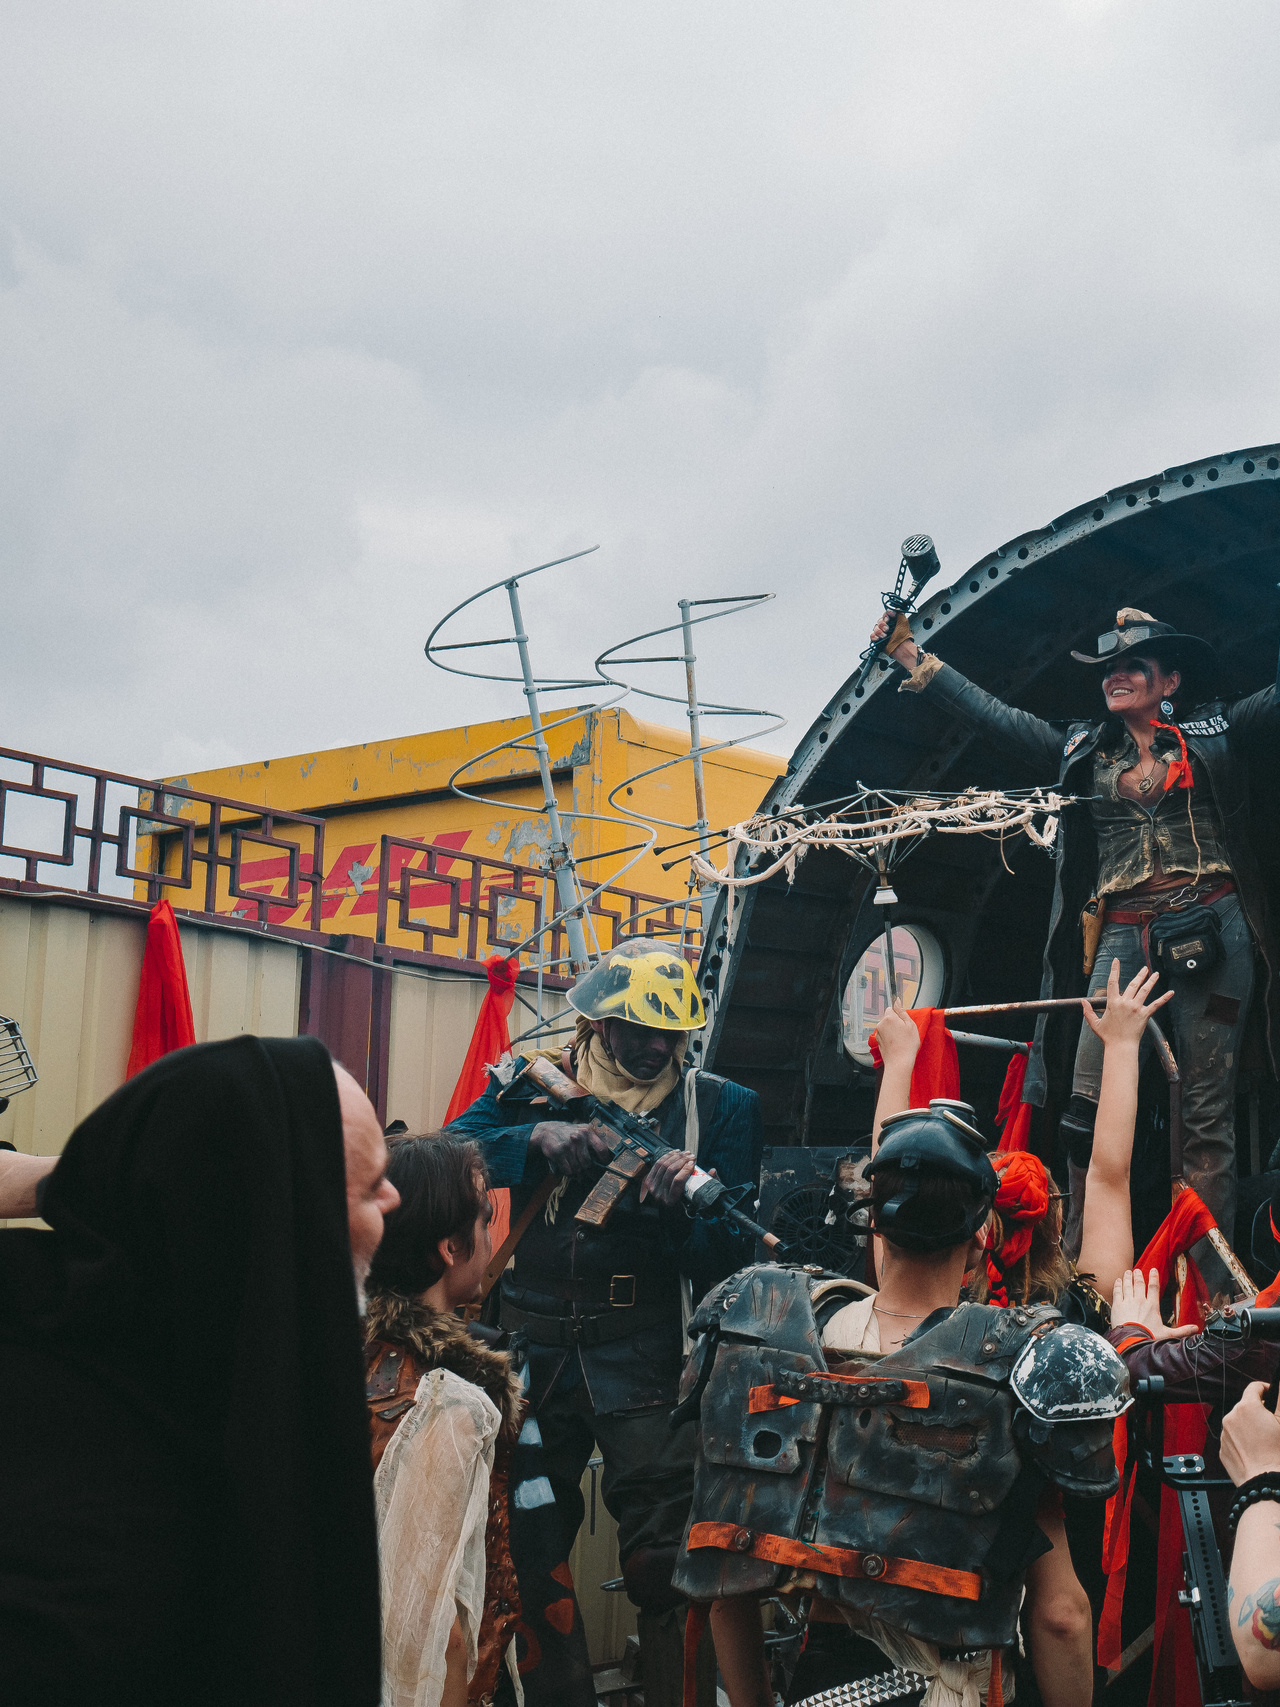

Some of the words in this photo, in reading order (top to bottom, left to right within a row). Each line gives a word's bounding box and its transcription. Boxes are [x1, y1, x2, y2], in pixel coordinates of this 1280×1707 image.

[1178, 720, 1209, 730] AFTER
[1209, 714, 1224, 726] US
[1185, 720, 1230, 736] MEMBER
